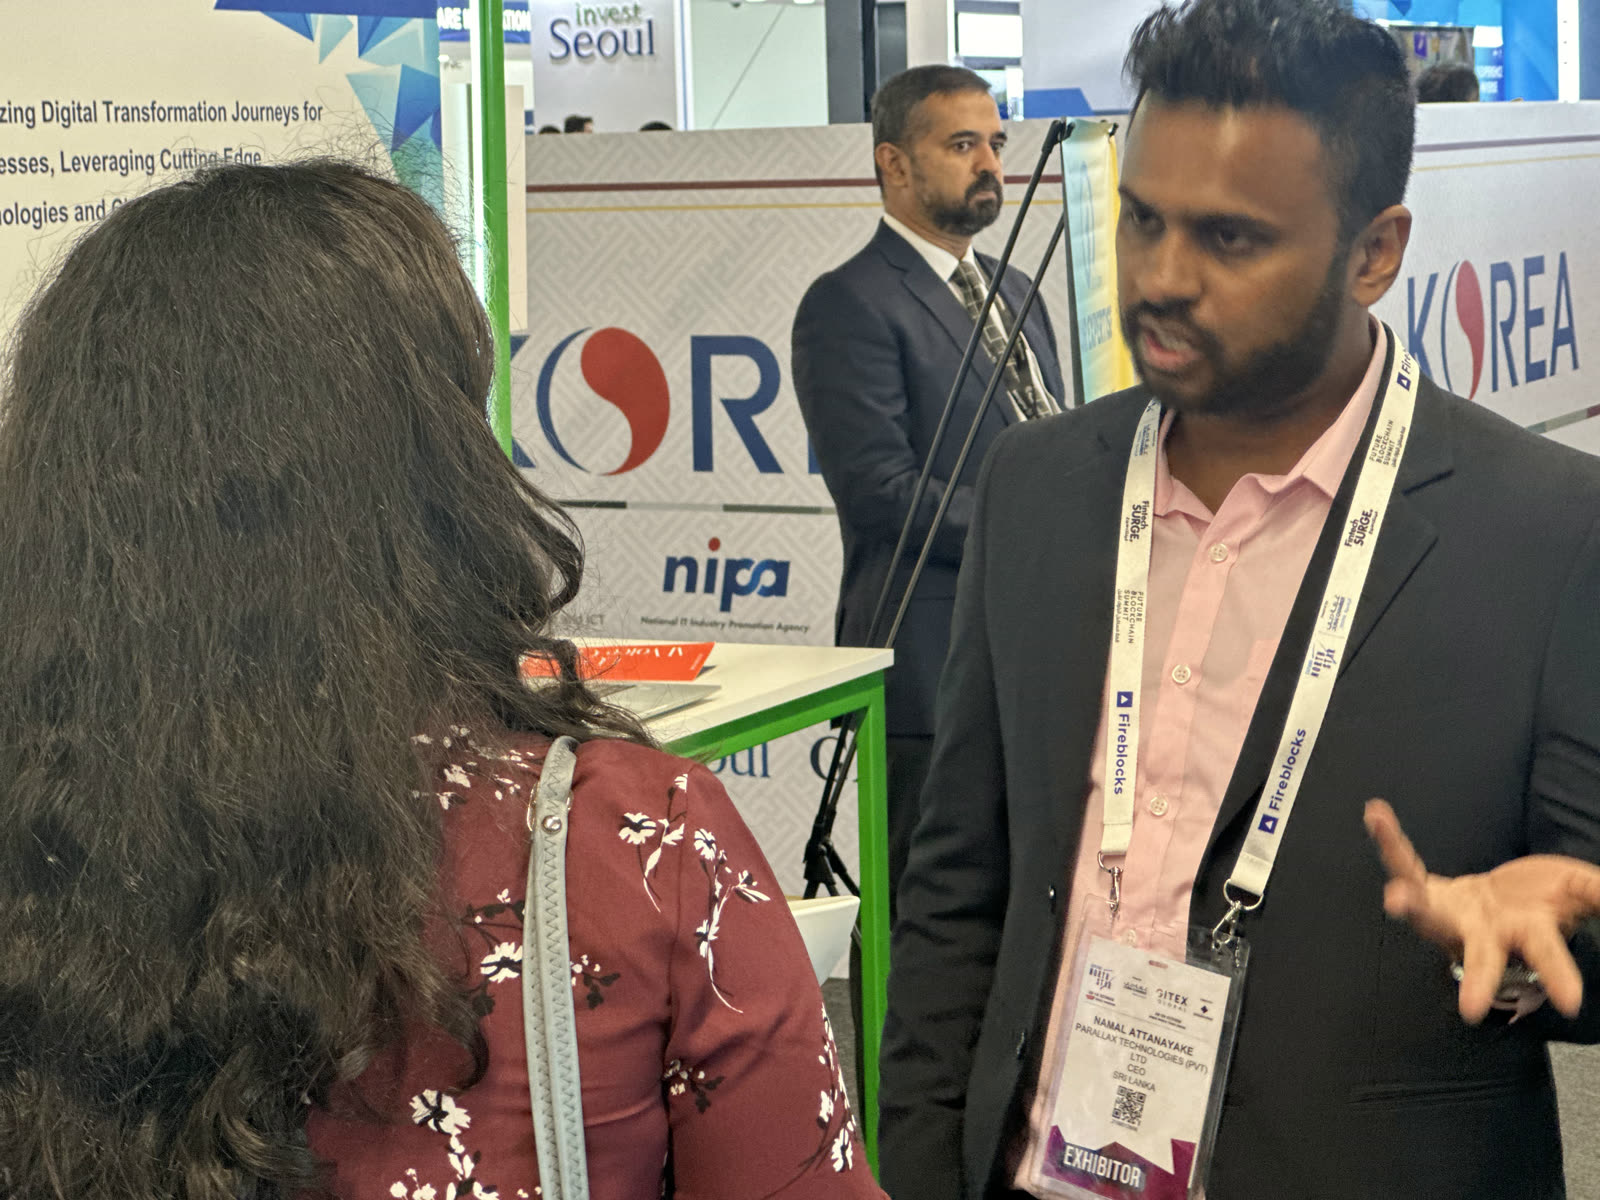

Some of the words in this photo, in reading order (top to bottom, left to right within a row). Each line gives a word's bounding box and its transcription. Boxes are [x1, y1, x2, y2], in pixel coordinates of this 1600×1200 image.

[575, 2, 643, 26] invest
[549, 18, 655, 61] Seoul
[0, 102, 36, 128] zing
[42, 101, 98, 128] Digital
[102, 101, 228, 123] Transformation
[231, 101, 300, 127] Journeys
[303, 101, 323, 121] for
[60, 150, 155, 176] Leveraging
[160, 147, 218, 170] Cutting
[223, 148, 262, 167] Edge
[74, 200, 106, 222] and
[1406, 250, 1580, 400] KOREA
[1368, 434, 1383, 462] FUTURE
[1376, 420, 1394, 465] BLOCKCHAIN
[1383, 439, 1396, 466] SUMMIT
[1141, 500, 1150, 531] Fintech
[1344, 518, 1359, 548] Fintech
[662, 536, 790, 613] nipa
[1122, 589, 1131, 622] SUMMIT
[1128, 590, 1138, 645] BLOCKCHAIN
[1136, 591, 1144, 623] FUTURE
[640, 616, 677, 627] National
[680, 616, 689, 627] IT
[690, 617, 726, 630] Industry
[728, 618, 774, 631] Promotion
[776, 621, 810, 633] Agency
[1114, 713, 1131, 795] Fireblocks
[1268, 727, 1307, 812] Fireblocks
[1075, 1022, 1117, 1044] PARALLAX
[1119, 1035, 1184, 1067] TECHNOLOGIES
[1185, 1057, 1209, 1076] (PVT)
[1093, 1015, 1127, 1036] NAMAL
[1129, 1028, 1194, 1057] ATTANAYAKE
[1127, 1063, 1147, 1077] CEO
[1130, 1053, 1147, 1065] LTD
[1112, 1070, 1128, 1083] SRI
[1128, 1076, 1156, 1093] LANKA
[1063, 1145, 1142, 1190] EXHIBITOR
